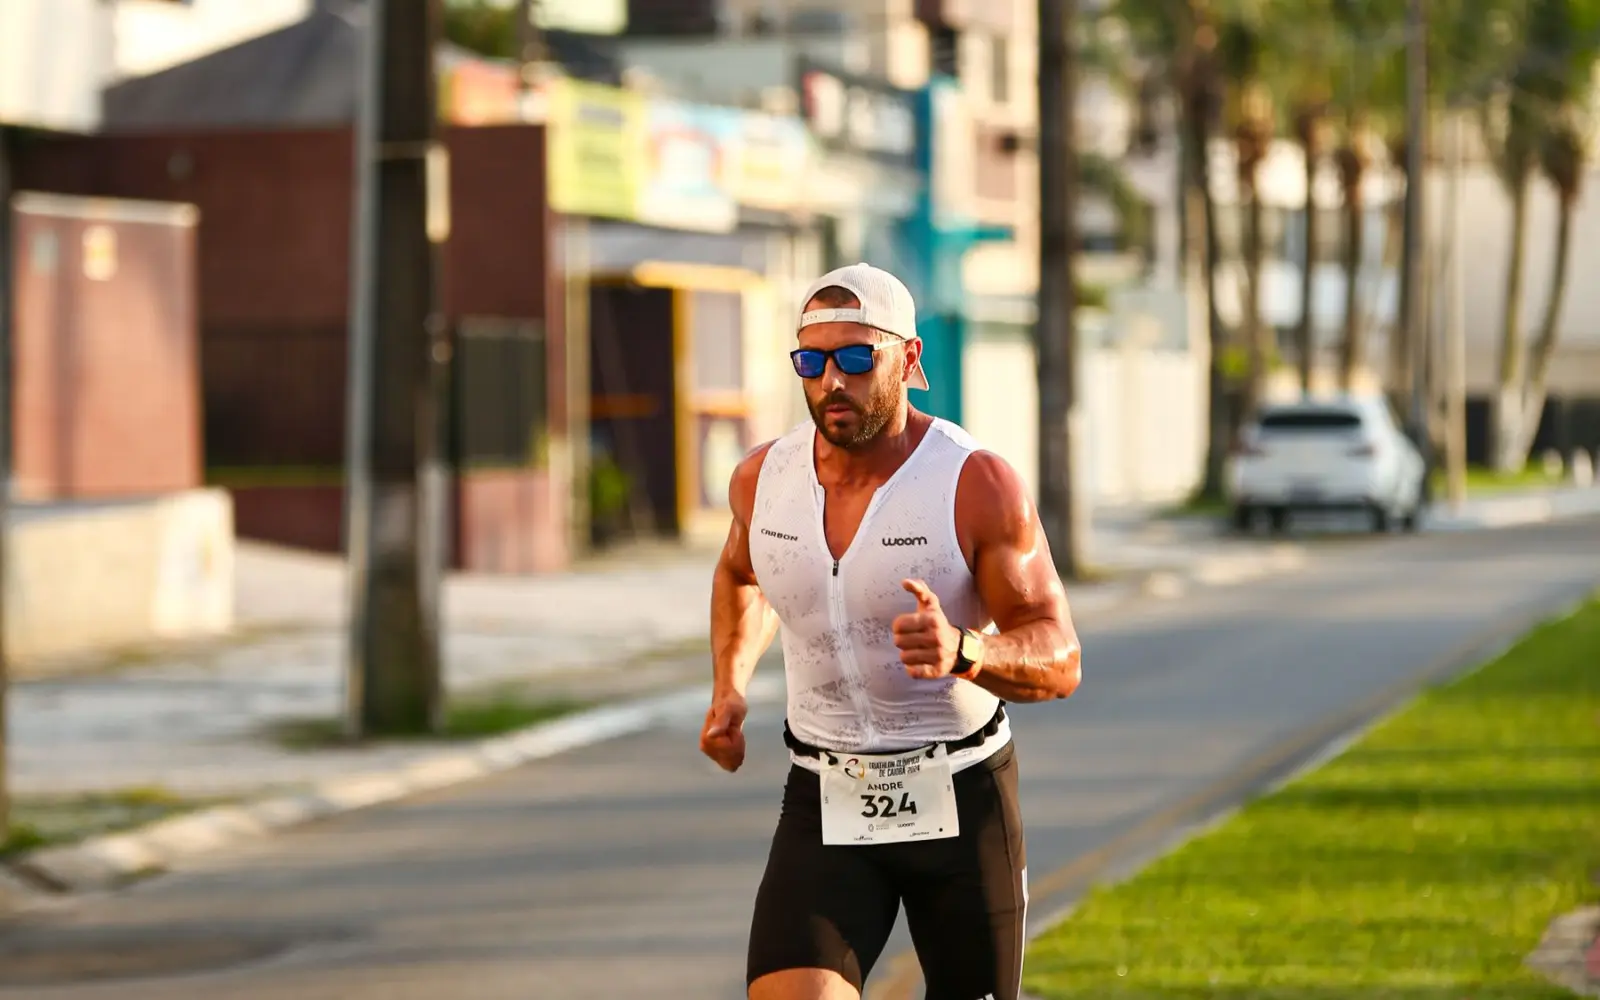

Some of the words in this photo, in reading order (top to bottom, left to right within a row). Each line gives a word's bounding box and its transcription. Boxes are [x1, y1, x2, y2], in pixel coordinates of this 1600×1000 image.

[760, 528, 799, 542] CARBON
[882, 536, 928, 547] woom
[867, 781, 904, 792] ANDRE
[860, 792, 918, 818] 324
